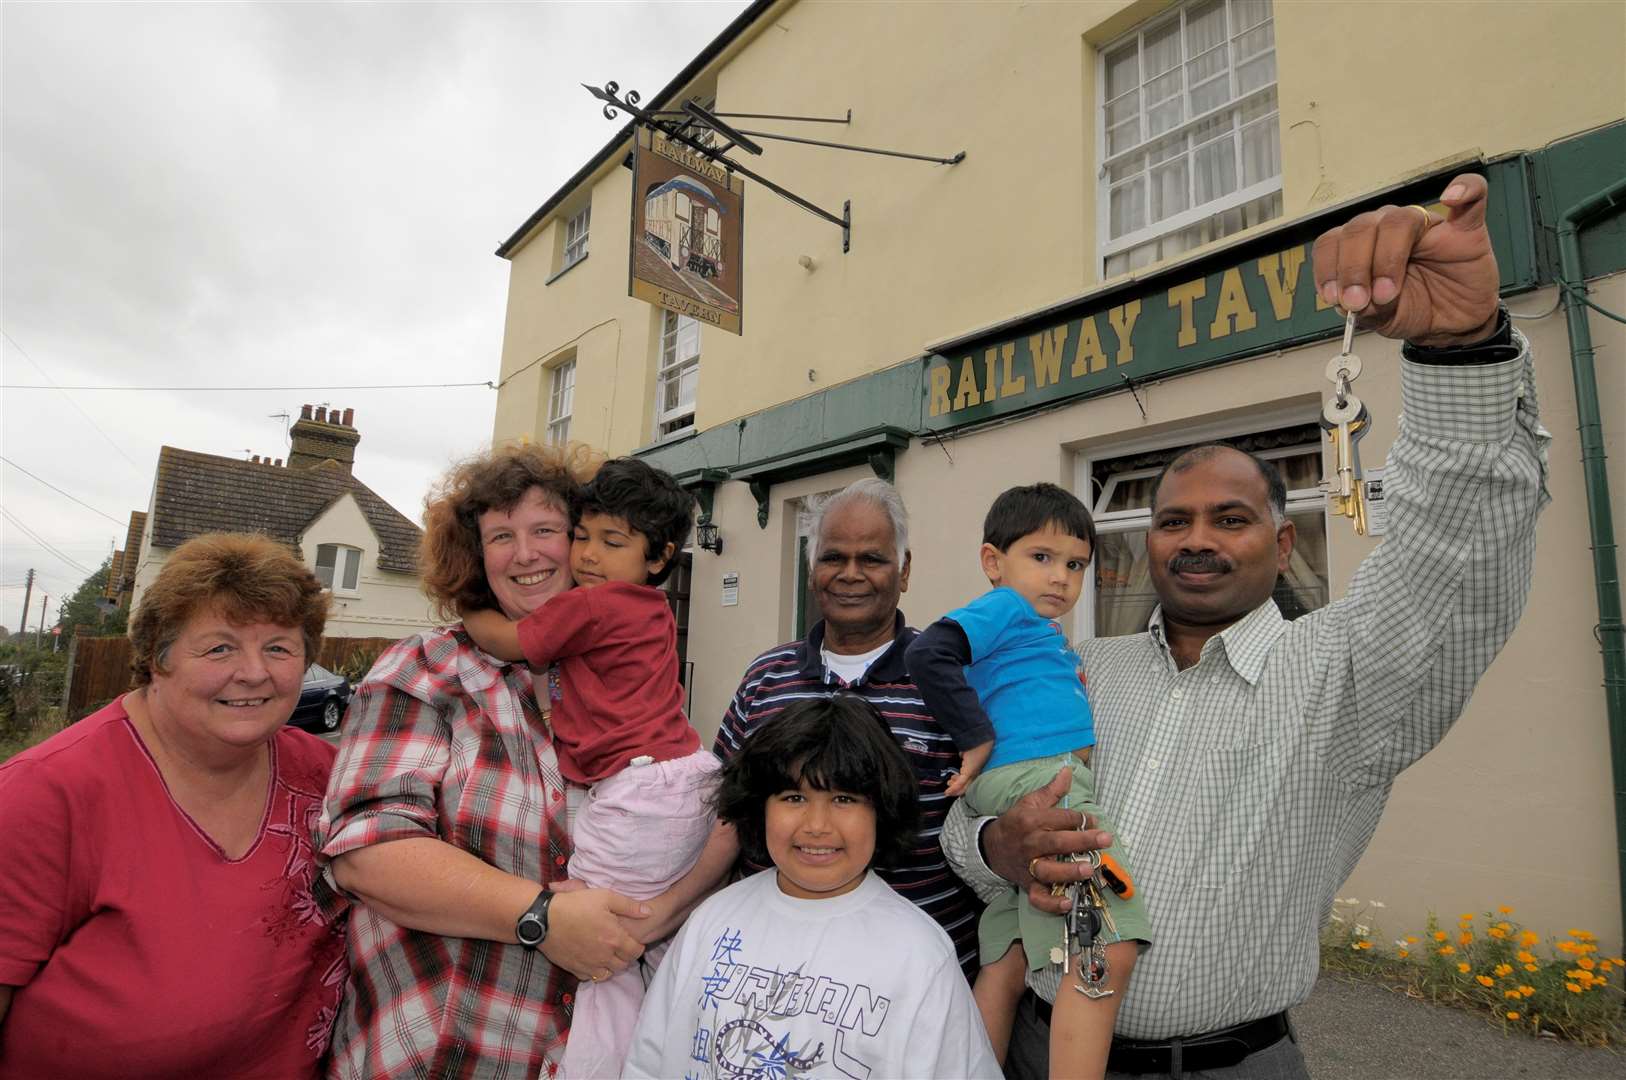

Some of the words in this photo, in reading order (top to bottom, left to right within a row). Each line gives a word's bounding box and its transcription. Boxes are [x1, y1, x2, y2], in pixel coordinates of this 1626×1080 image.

[655, 138, 725, 185] RAILWAY
[657, 291, 721, 324] TAVERN
[929, 299, 1141, 417] RAILWAY
[709, 962, 890, 1036] URBAN
